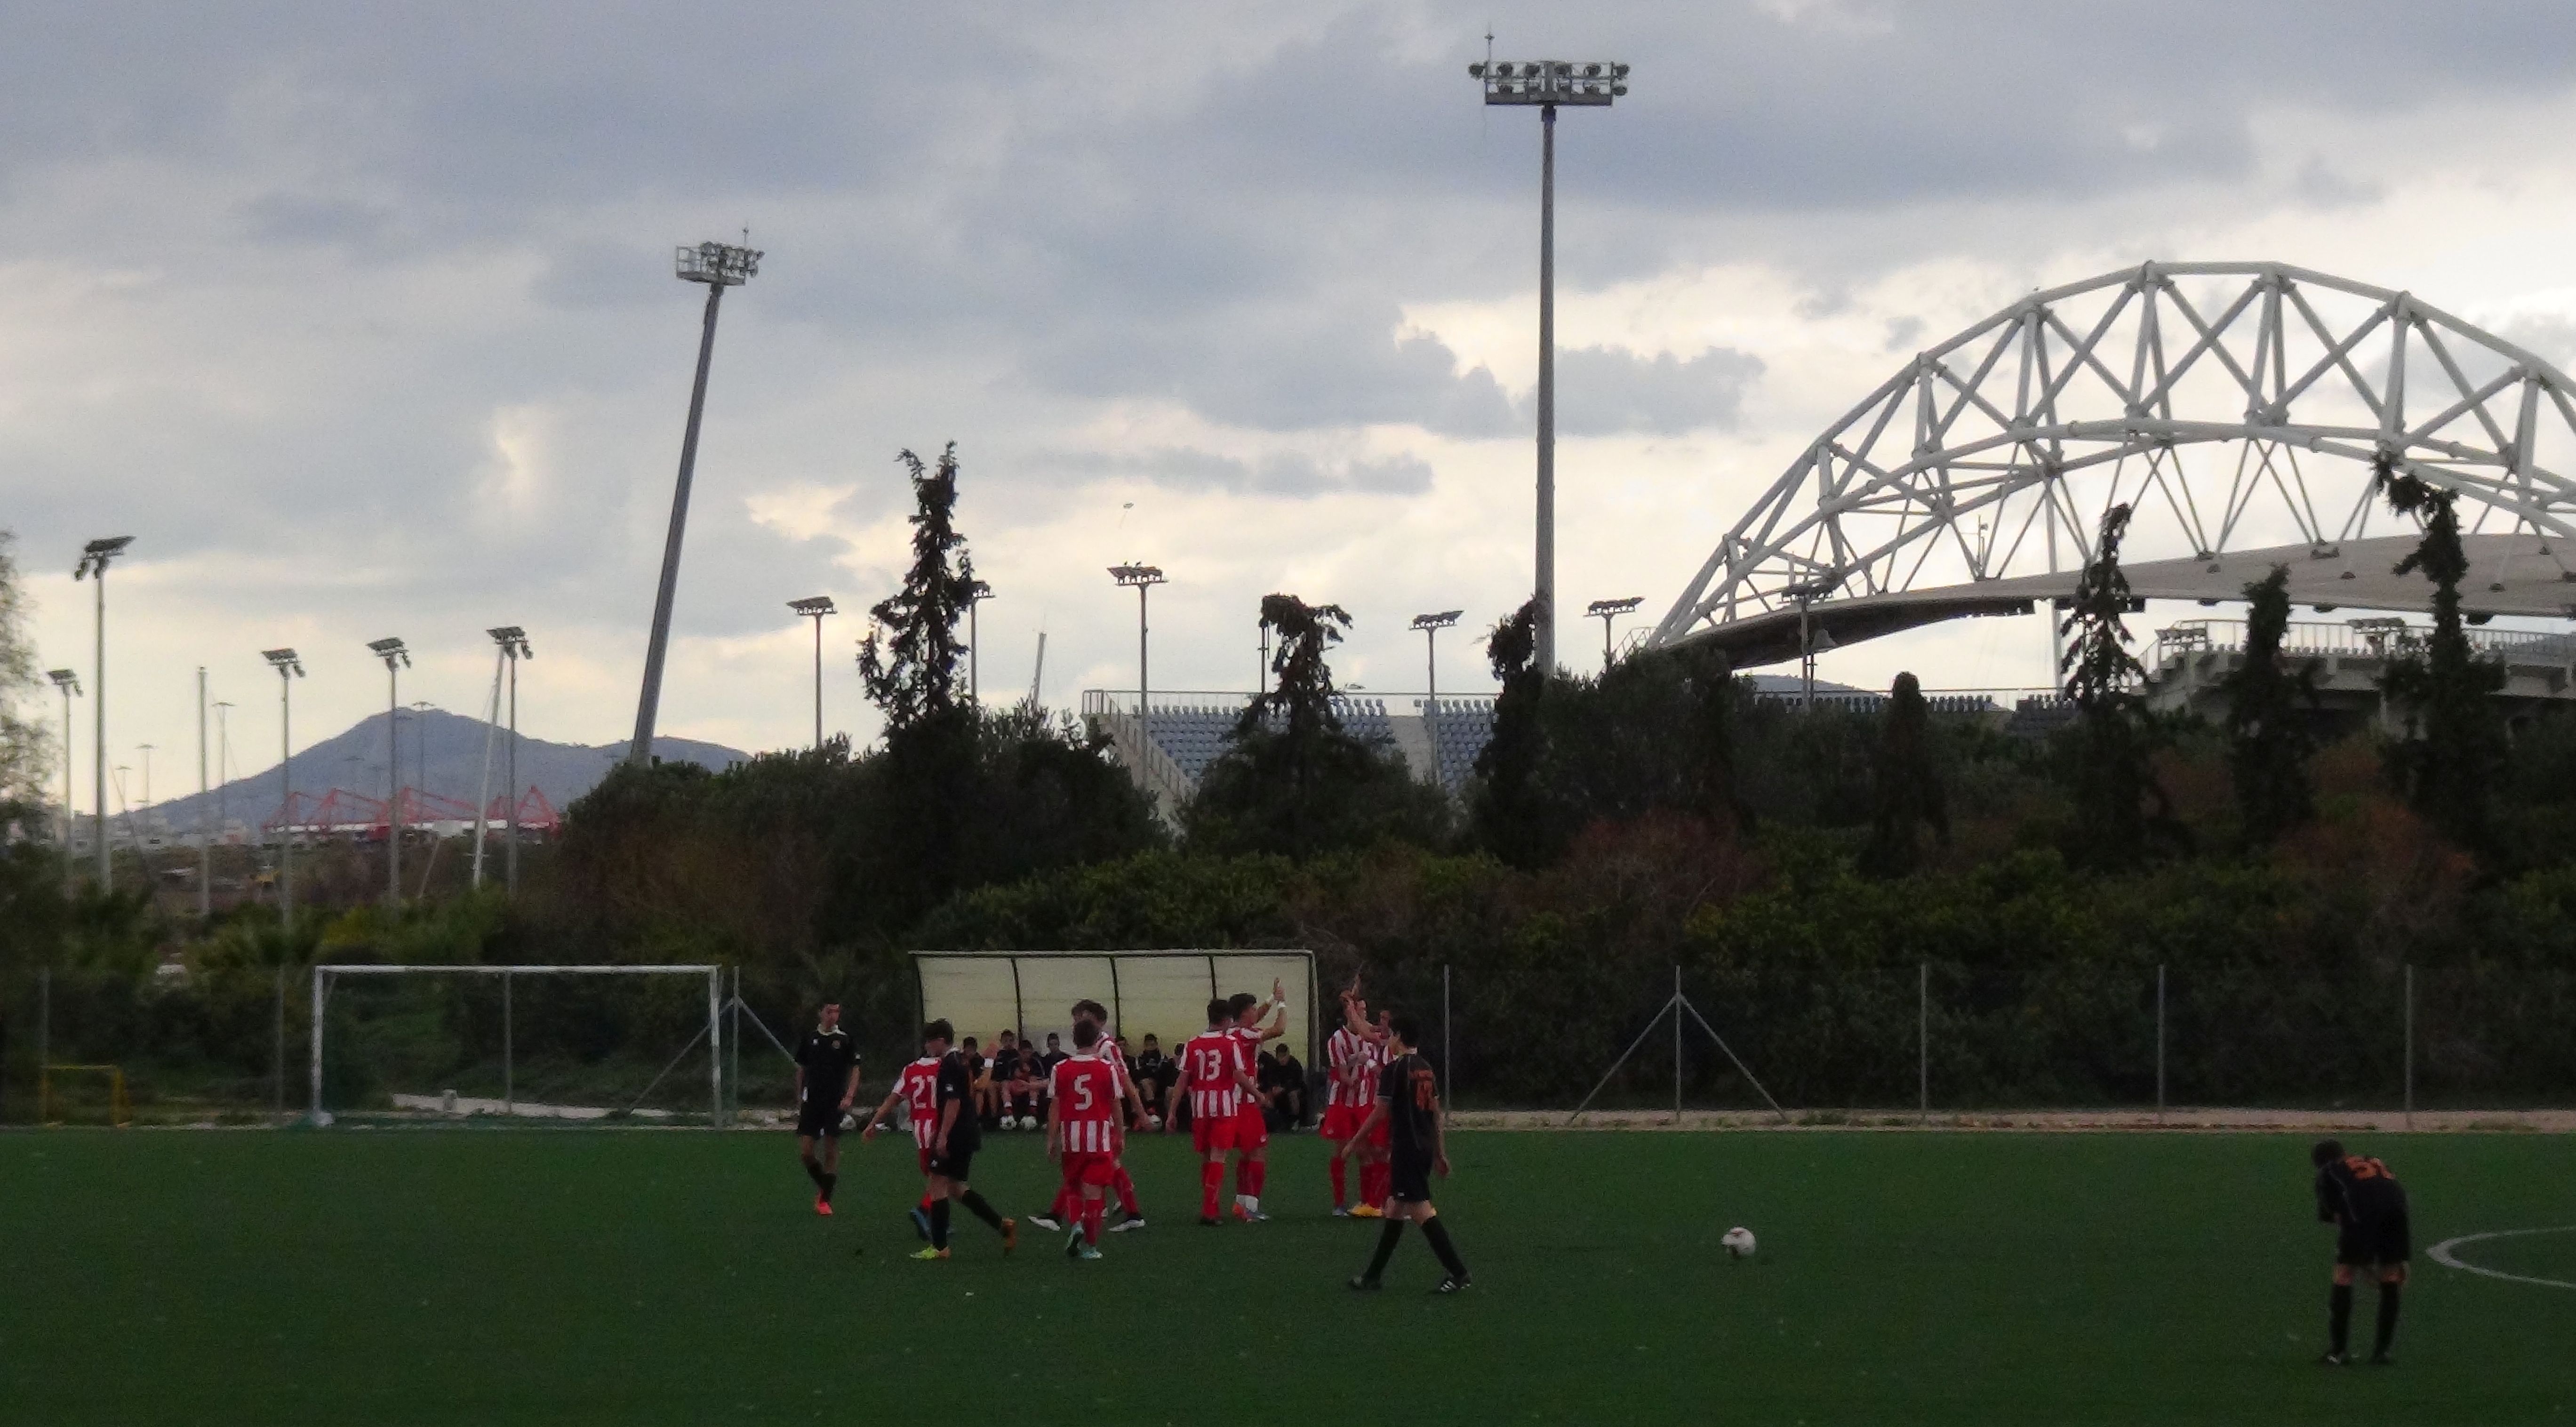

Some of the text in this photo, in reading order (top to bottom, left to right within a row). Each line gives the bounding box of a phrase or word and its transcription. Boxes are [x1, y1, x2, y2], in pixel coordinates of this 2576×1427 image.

[1194, 1049, 1222, 1081] 13
[911, 1075, 937, 1109] 21
[1074, 1074, 1093, 1110] 5
